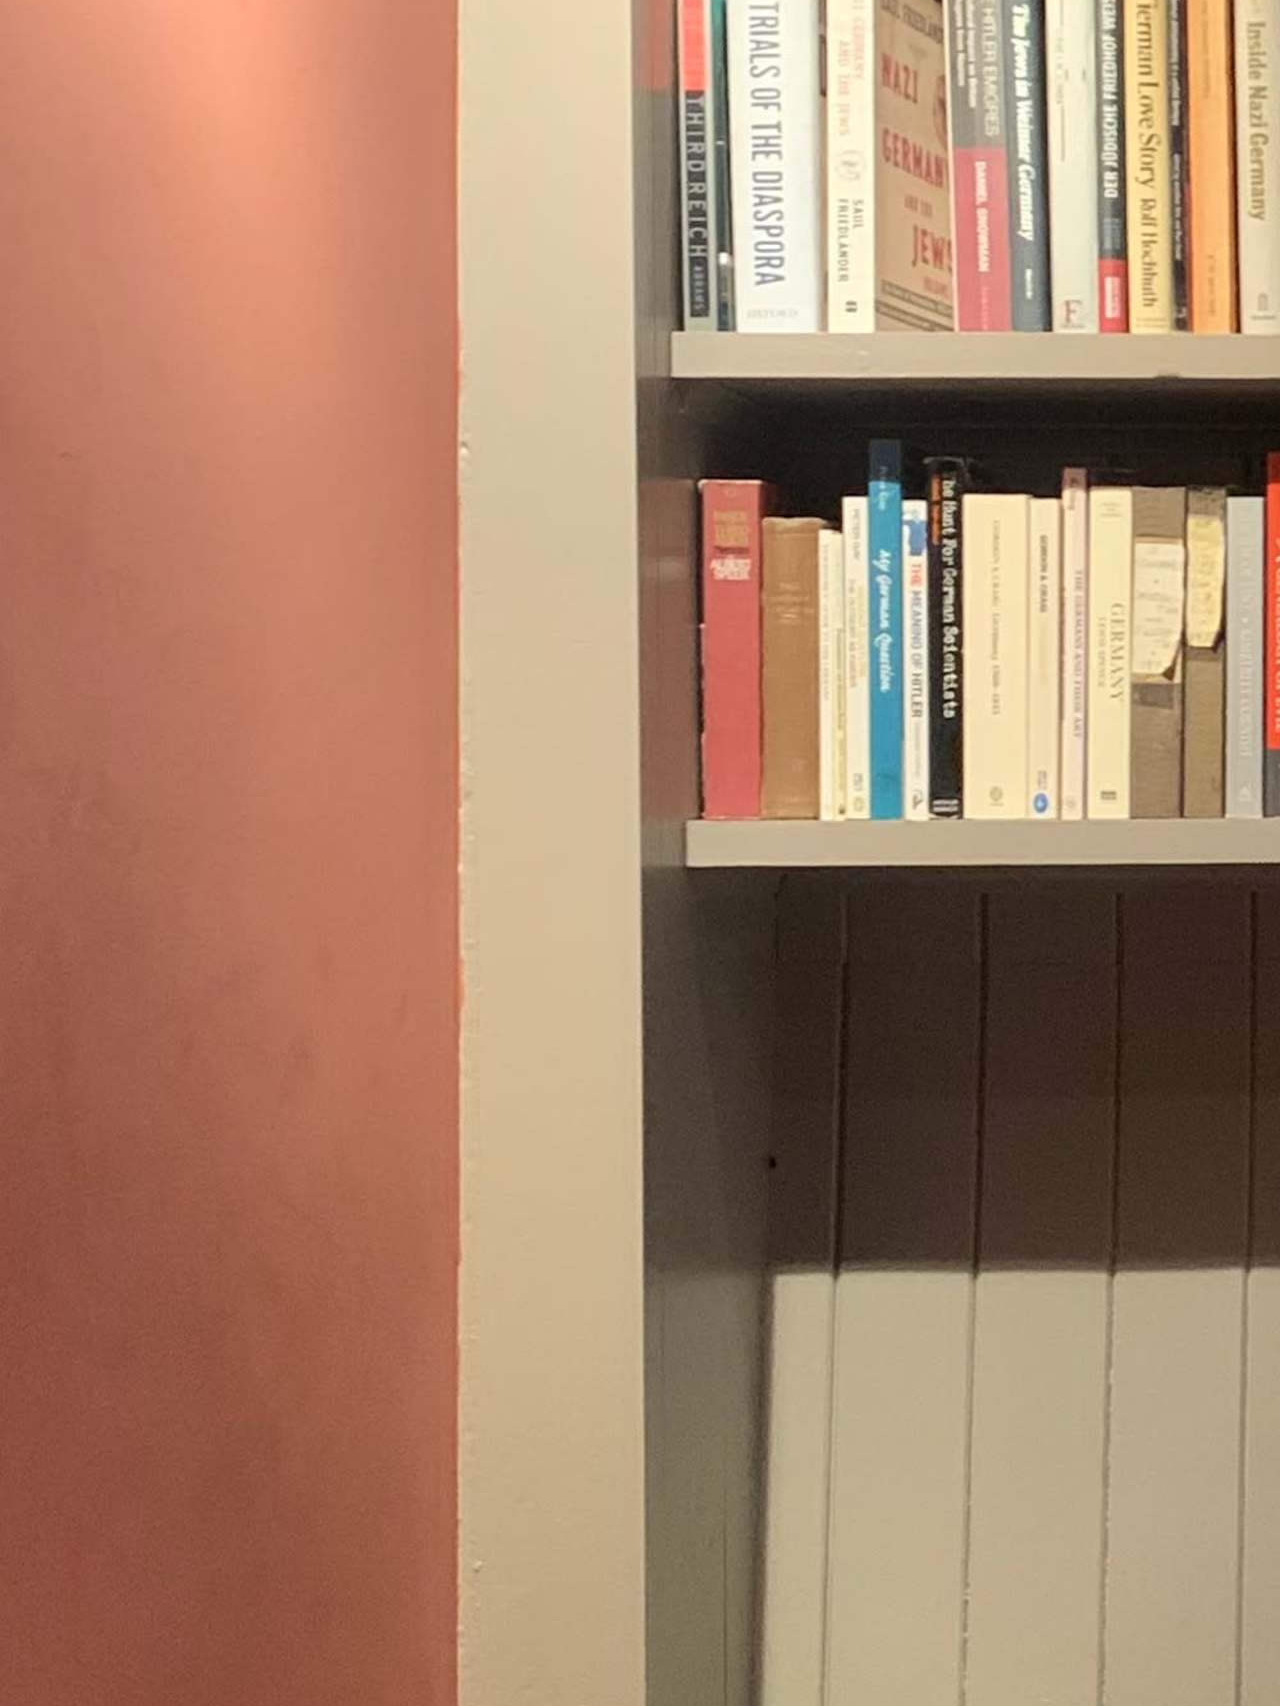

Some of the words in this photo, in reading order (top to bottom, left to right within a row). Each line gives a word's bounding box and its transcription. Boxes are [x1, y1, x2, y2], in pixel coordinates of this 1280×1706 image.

[748, 1, 782, 79] TRIALS
[1012, 3, 1031, 36] The
[1008, 38, 1031, 71] Jews
[1101, 34, 1118, 99] FRIEDHOF
[1246, 20, 1267, 81] Inside
[750, 87, 782, 112] OF
[881, 52, 919, 104] NAZI
[1014, 75, 1032, 93] in
[1136, 81, 1160, 129] Love
[1248, 85, 1270, 127] Nazi
[750, 121, 784, 162] THE
[1014, 98, 1035, 161] Weimar
[1102, 103, 1120, 168] JÜDISCHE
[974, 160, 988, 206] DANIEL
[1134, 131, 1162, 190] Story
[1246, 132, 1271, 221] Germany
[1015, 163, 1037, 240] Germany
[1103, 172, 1119, 198] DER
[752, 170, 787, 287] DIASPORA
[852, 198, 865, 229] SAUL
[1139, 197, 1158, 228] Rolf
[836, 198, 850, 283] FRIEDLANDER
[975, 207, 991, 272] SNOWMAN
[1139, 231, 1159, 308] Hochhuth
[873, 549, 892, 569] My
[910, 562, 922, 586] THE
[1074, 571, 1088, 592] THE
[877, 573, 893, 631] German
[910, 589, 923, 650] MEANING
[1074, 594, 1088, 652] GERMANS
[873, 632, 896, 694] Question
[910, 652, 923, 669] OF
[1073, 651, 1087, 678] AND
[1109, 603, 1128, 702] GERMANY
[910, 672, 924, 718] HITLER
[1073, 680, 1087, 713] THEIR
[1073, 715, 1087, 739] ART
